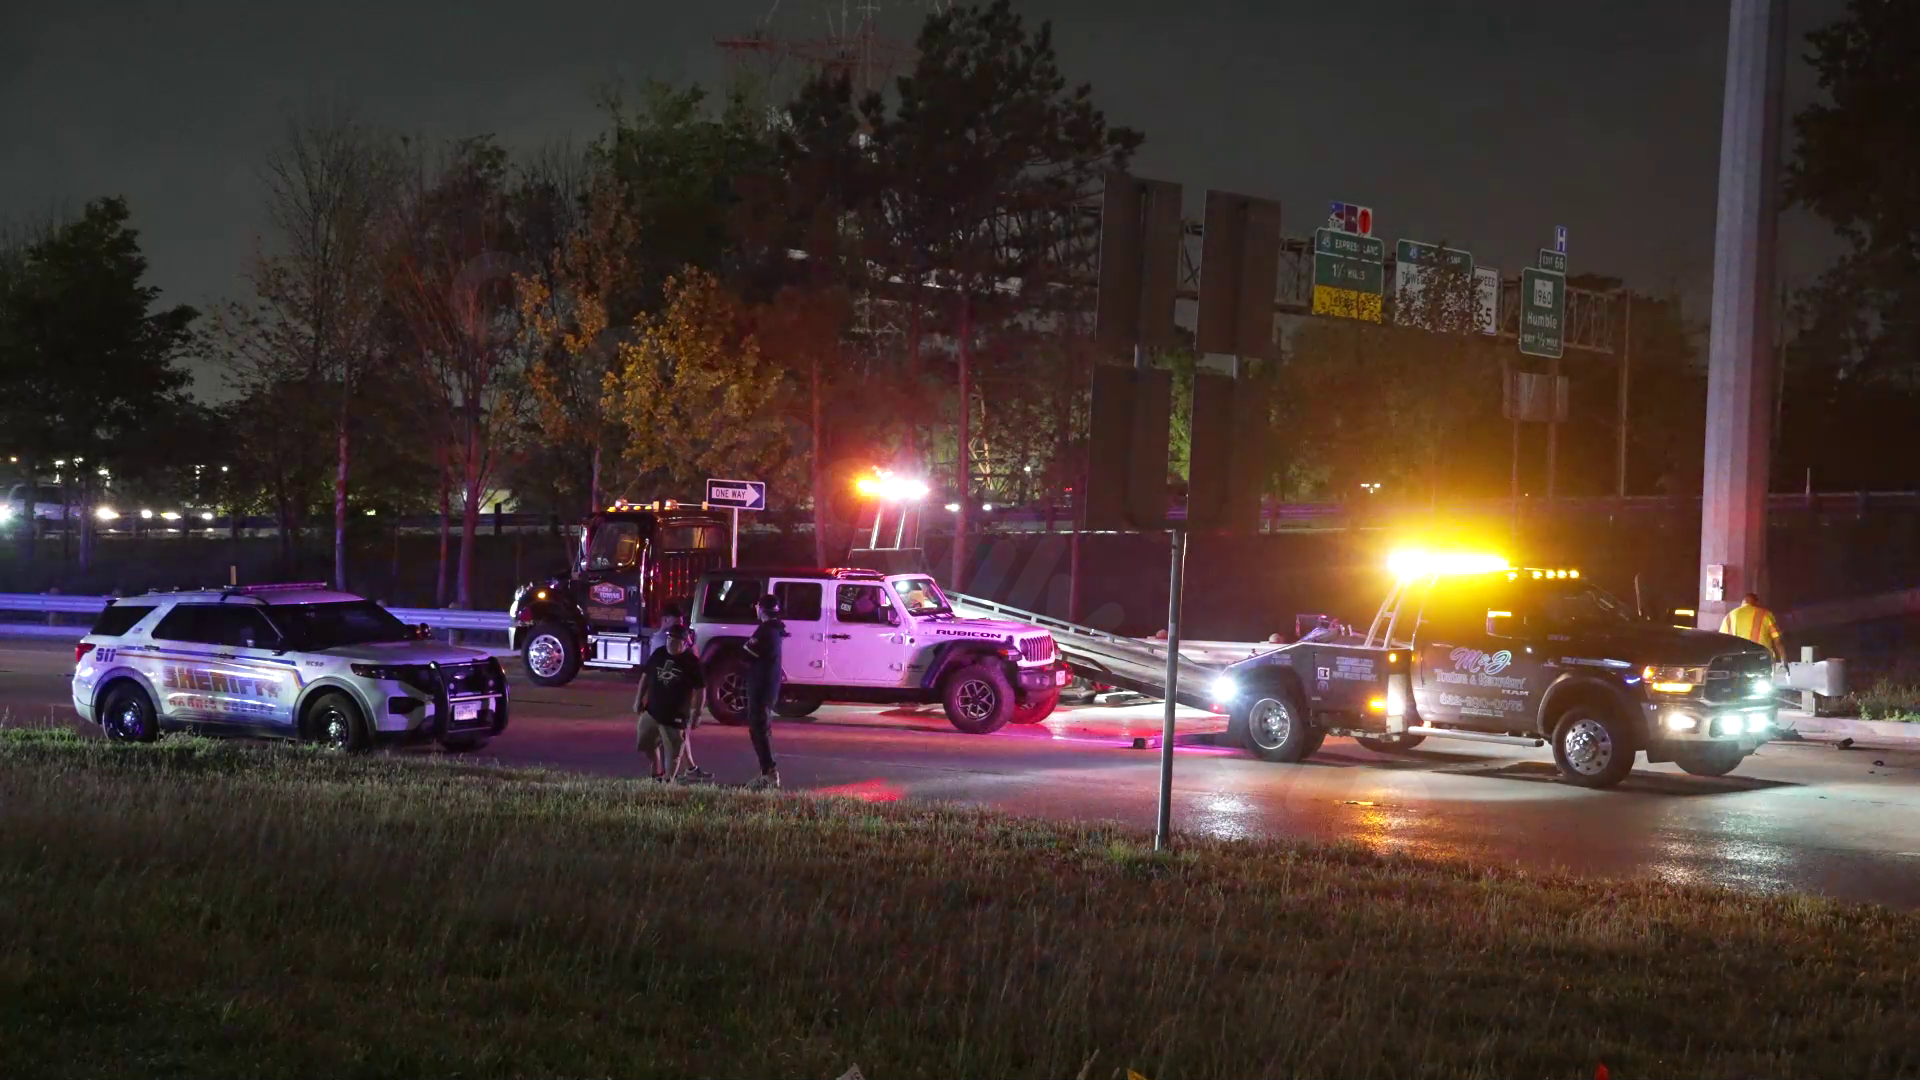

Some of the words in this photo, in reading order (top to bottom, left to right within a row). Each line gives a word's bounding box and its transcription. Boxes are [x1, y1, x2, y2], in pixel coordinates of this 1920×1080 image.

[1535, 289, 1552, 305] 1960
[1527, 311, 1558, 329] Humble
[716, 488, 730, 498] ONE
[731, 490, 746, 500] WAY
[936, 629, 1002, 639] RUBICON
[96, 648, 116, 662] 911
[163, 665, 272, 698] SHERIFF
[1501, 689, 1530, 697] RAM
